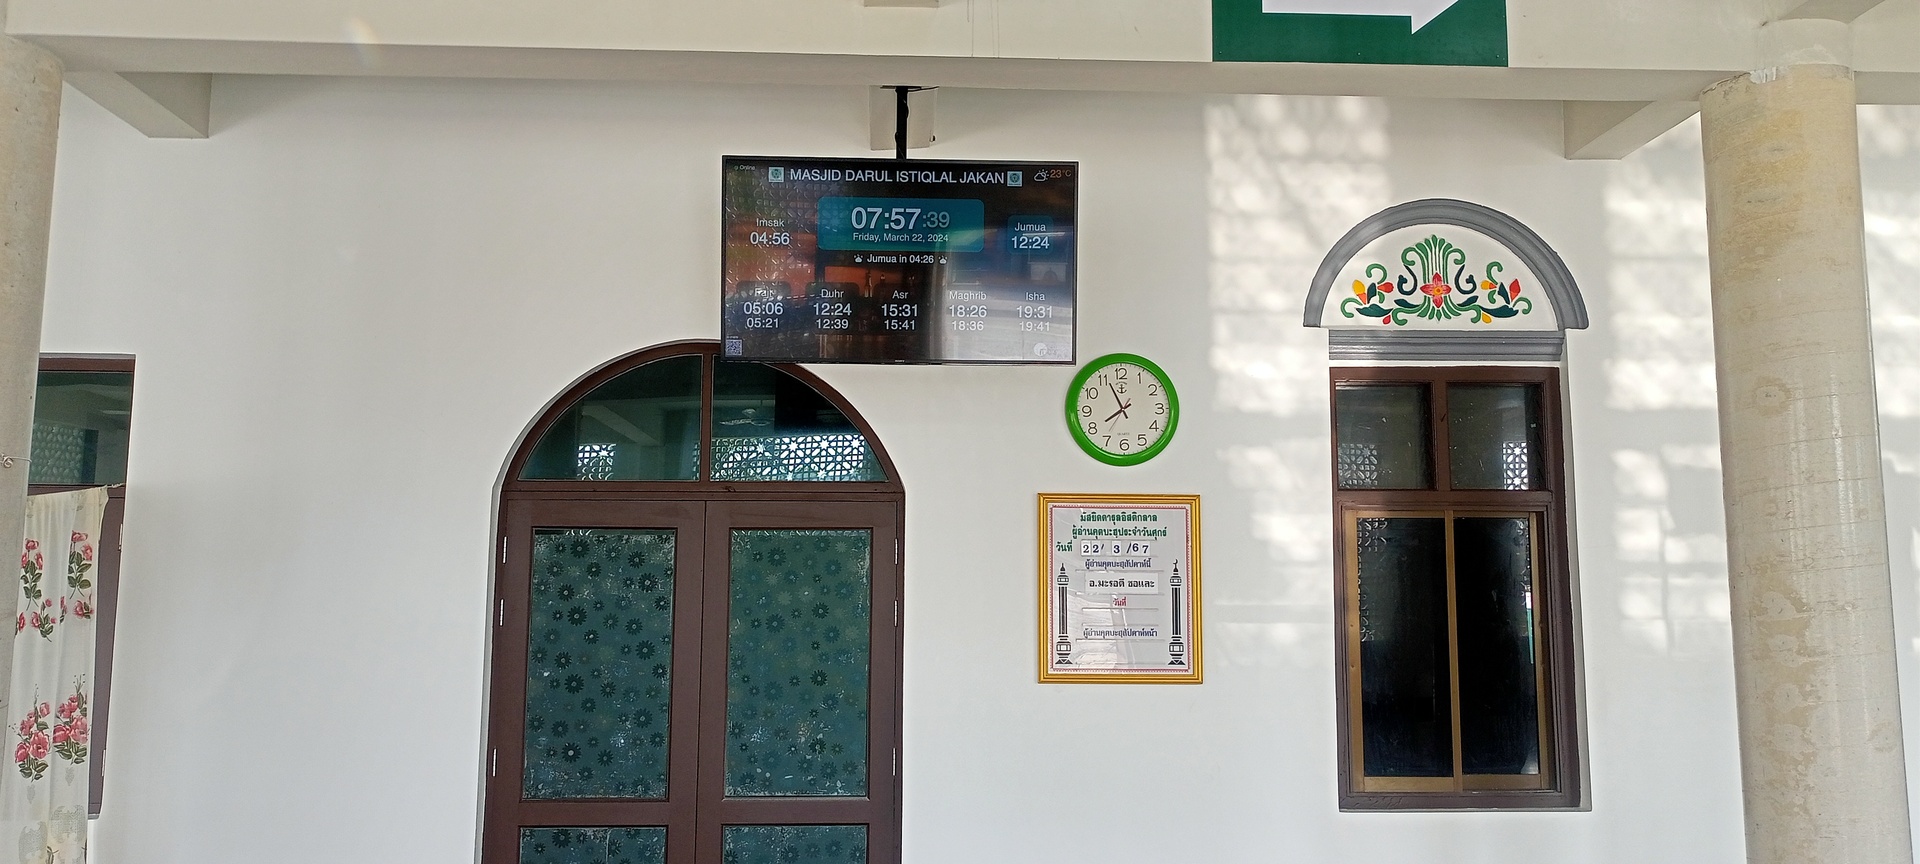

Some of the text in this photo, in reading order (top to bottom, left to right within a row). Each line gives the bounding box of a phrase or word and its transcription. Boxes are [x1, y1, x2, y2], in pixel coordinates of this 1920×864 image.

[790, 168, 1005, 184] MASJID DARUL ISTIQLAL JAKAN
[756, 217, 785, 227] Imsak
[1014, 222, 1046, 231] Jumua
[750, 231, 790, 245] 04:56
[852, 232, 949, 243] Friday, March 22, 2024
[1011, 236, 1050, 249] 12:24
[866, 254, 935, 264] Jumua in 04:26
[892, 290, 909, 299] Asr
[949, 291, 987, 302] Maghrib
[1025, 291, 1046, 301] Isha
[743, 301, 784, 315] 05:06
[813, 302, 852, 316] 12:24
[881, 303, 918, 317] 15:31
[949, 304, 988, 318] 18:26
[1016, 305, 1053, 319] 19:31
[746, 317, 780, 329] 05:21
[816, 318, 849, 329] 12:39
[884, 319, 915, 330] 15:41
[951, 320, 984, 331] 18:36
[1019, 321, 1050, 332] 19:41
[1098, 374, 1108, 386] 11
[1114, 367, 1128, 380] 12
[1137, 372, 1142, 385] 1
[1085, 387, 1099, 400] 10
[1147, 383, 1158, 396] 2
[1081, 405, 1092, 418] 9
[1154, 402, 1165, 415] 3
[1087, 421, 1098, 435] 8
[1148, 419, 1159, 432] 4
[1102, 435, 1112, 447] 7
[1119, 438, 1130, 451] 6
[1137, 433, 1148, 447] 5
[1056, 540, 1073, 552] วันที่
[1113, 544, 1121, 554] 3
